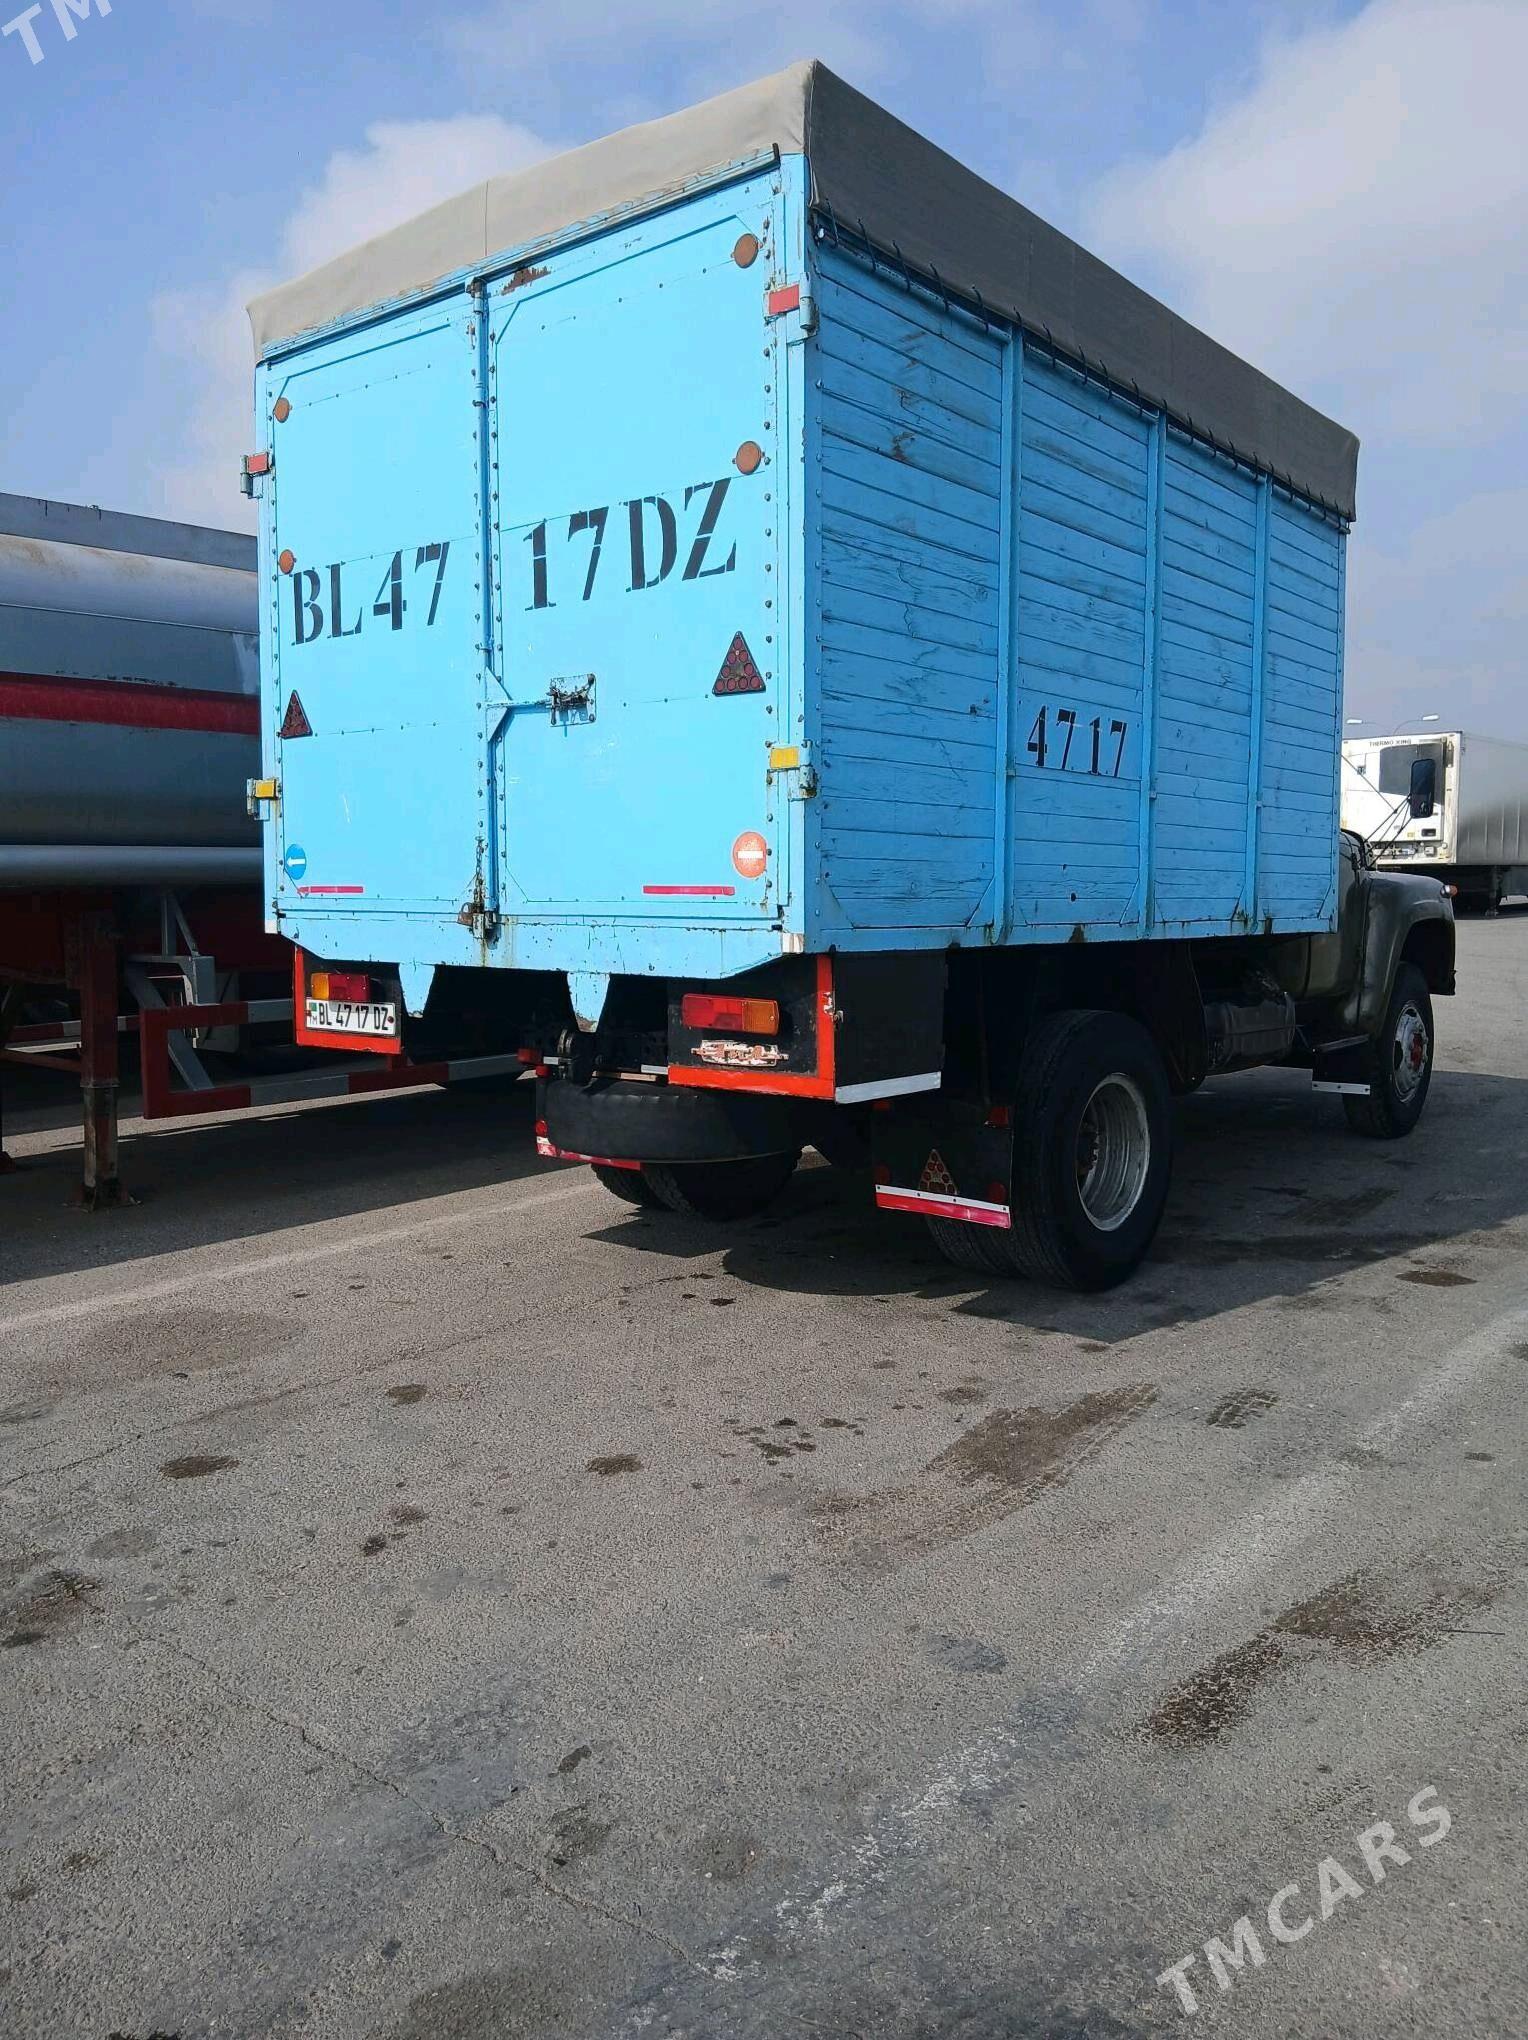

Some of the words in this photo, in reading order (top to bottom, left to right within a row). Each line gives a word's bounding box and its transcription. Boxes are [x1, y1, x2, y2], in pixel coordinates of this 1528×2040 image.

[290, 541, 451, 646] BL47
[523, 477, 736, 611] 17DZ
[1027, 704, 1128, 778] 4717
[318, 1002, 332, 1026] BL
[373, 1006, 389, 1031] DZ
